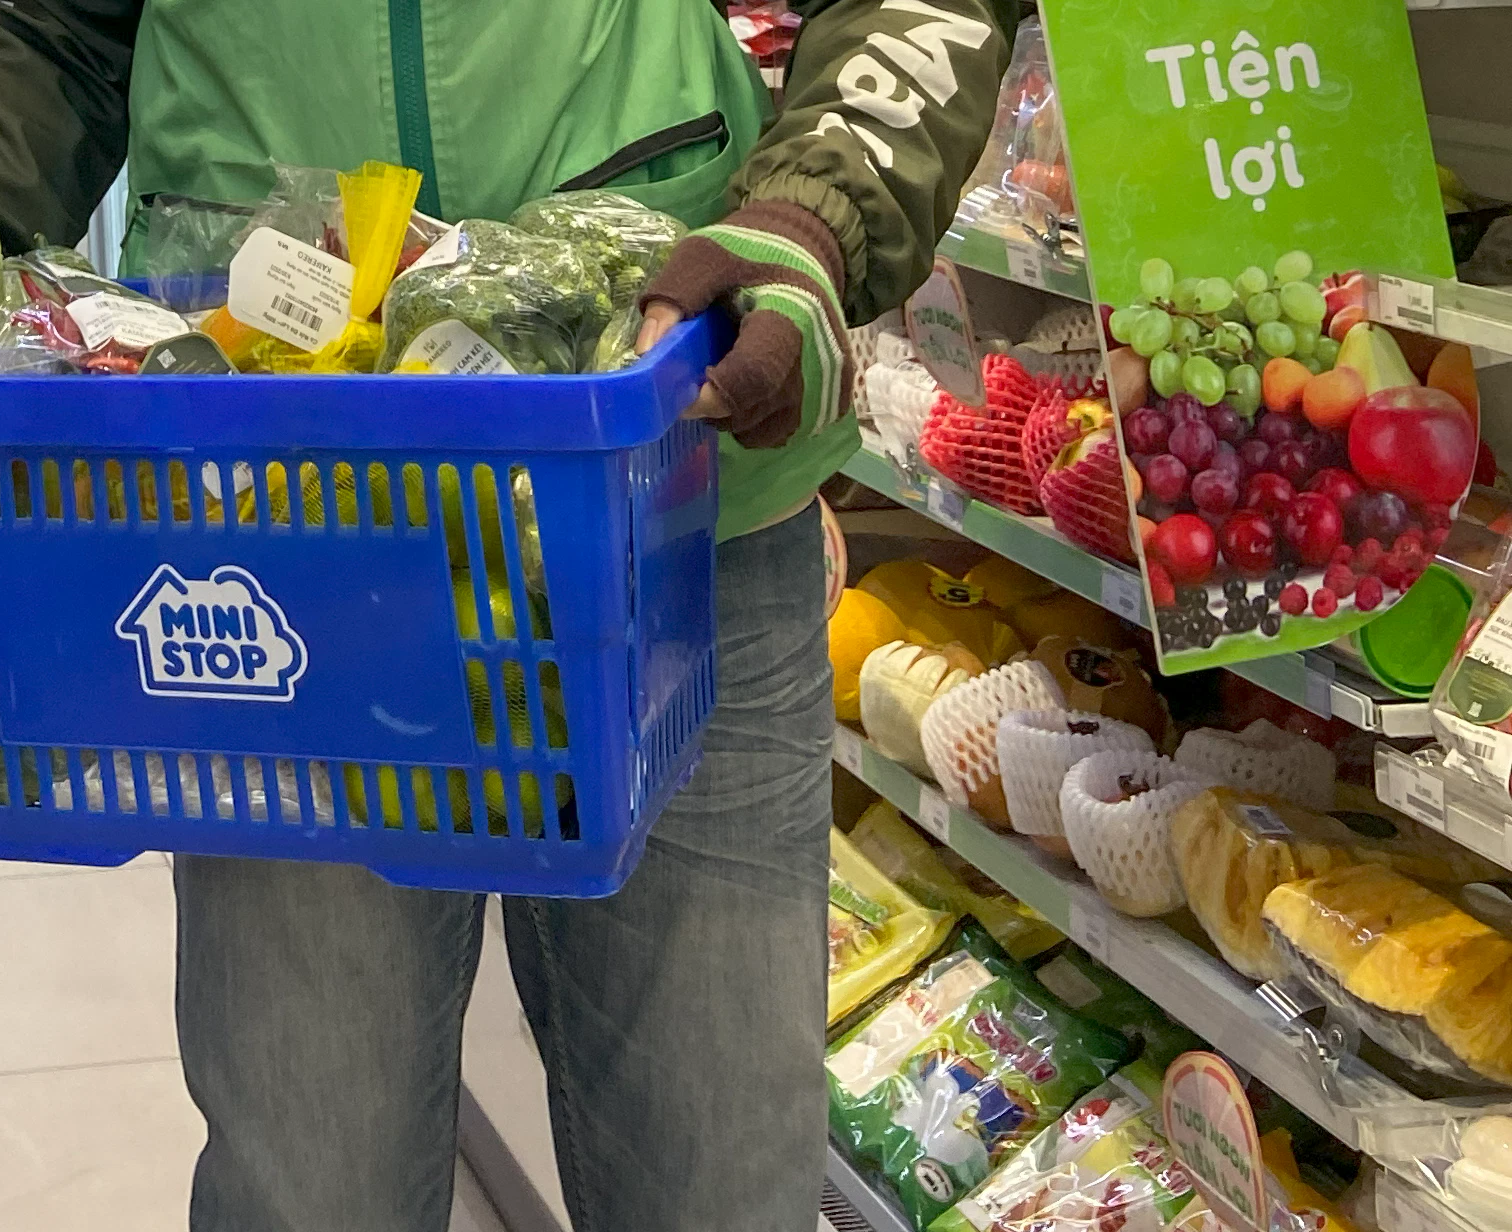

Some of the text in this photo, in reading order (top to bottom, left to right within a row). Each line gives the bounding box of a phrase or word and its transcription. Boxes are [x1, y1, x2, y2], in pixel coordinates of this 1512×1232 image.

[1145, 30, 1321, 115] Tiện
[1204, 125, 1305, 213] lợi
[159, 602, 258, 641] MINI
[161, 640, 267, 680] STOP
